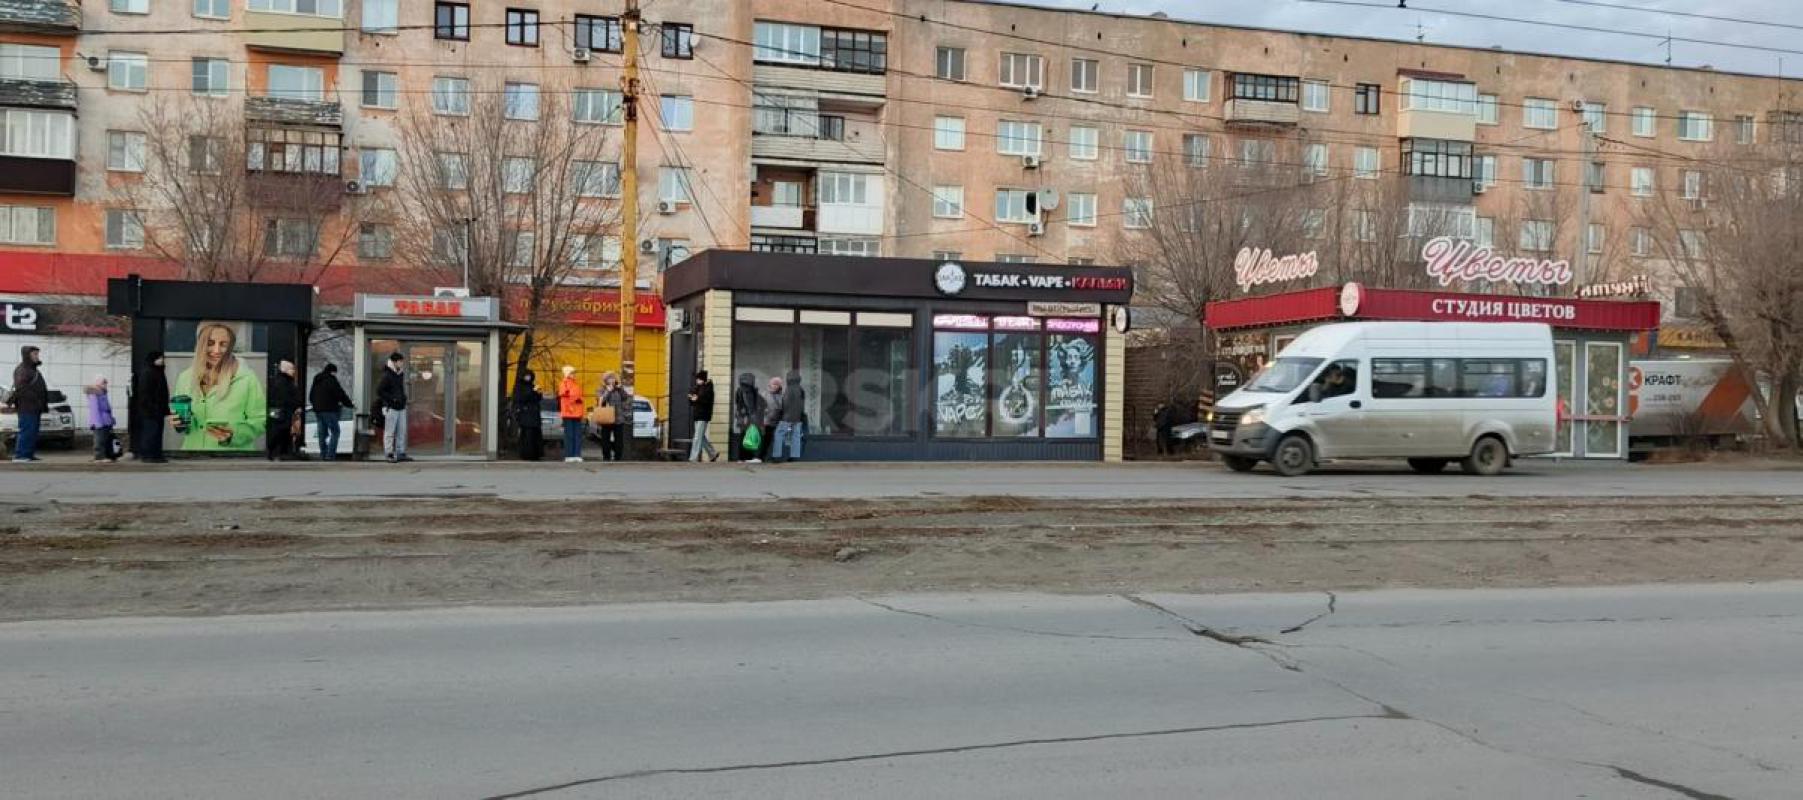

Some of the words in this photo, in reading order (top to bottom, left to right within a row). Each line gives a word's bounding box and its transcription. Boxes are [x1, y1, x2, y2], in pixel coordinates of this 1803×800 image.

[1234, 246, 1318, 292] Цветы
[1422, 236, 1572, 286] Цветы
[973, 273, 1020, 287] ТАБАК
[1029, 274, 1064, 287] VAPE
[1432, 299, 1501, 317] СТУДИЯ
[1508, 302, 1576, 319] ЦВЕТОВ
[1644, 375, 1681, 386] КРАФТ
